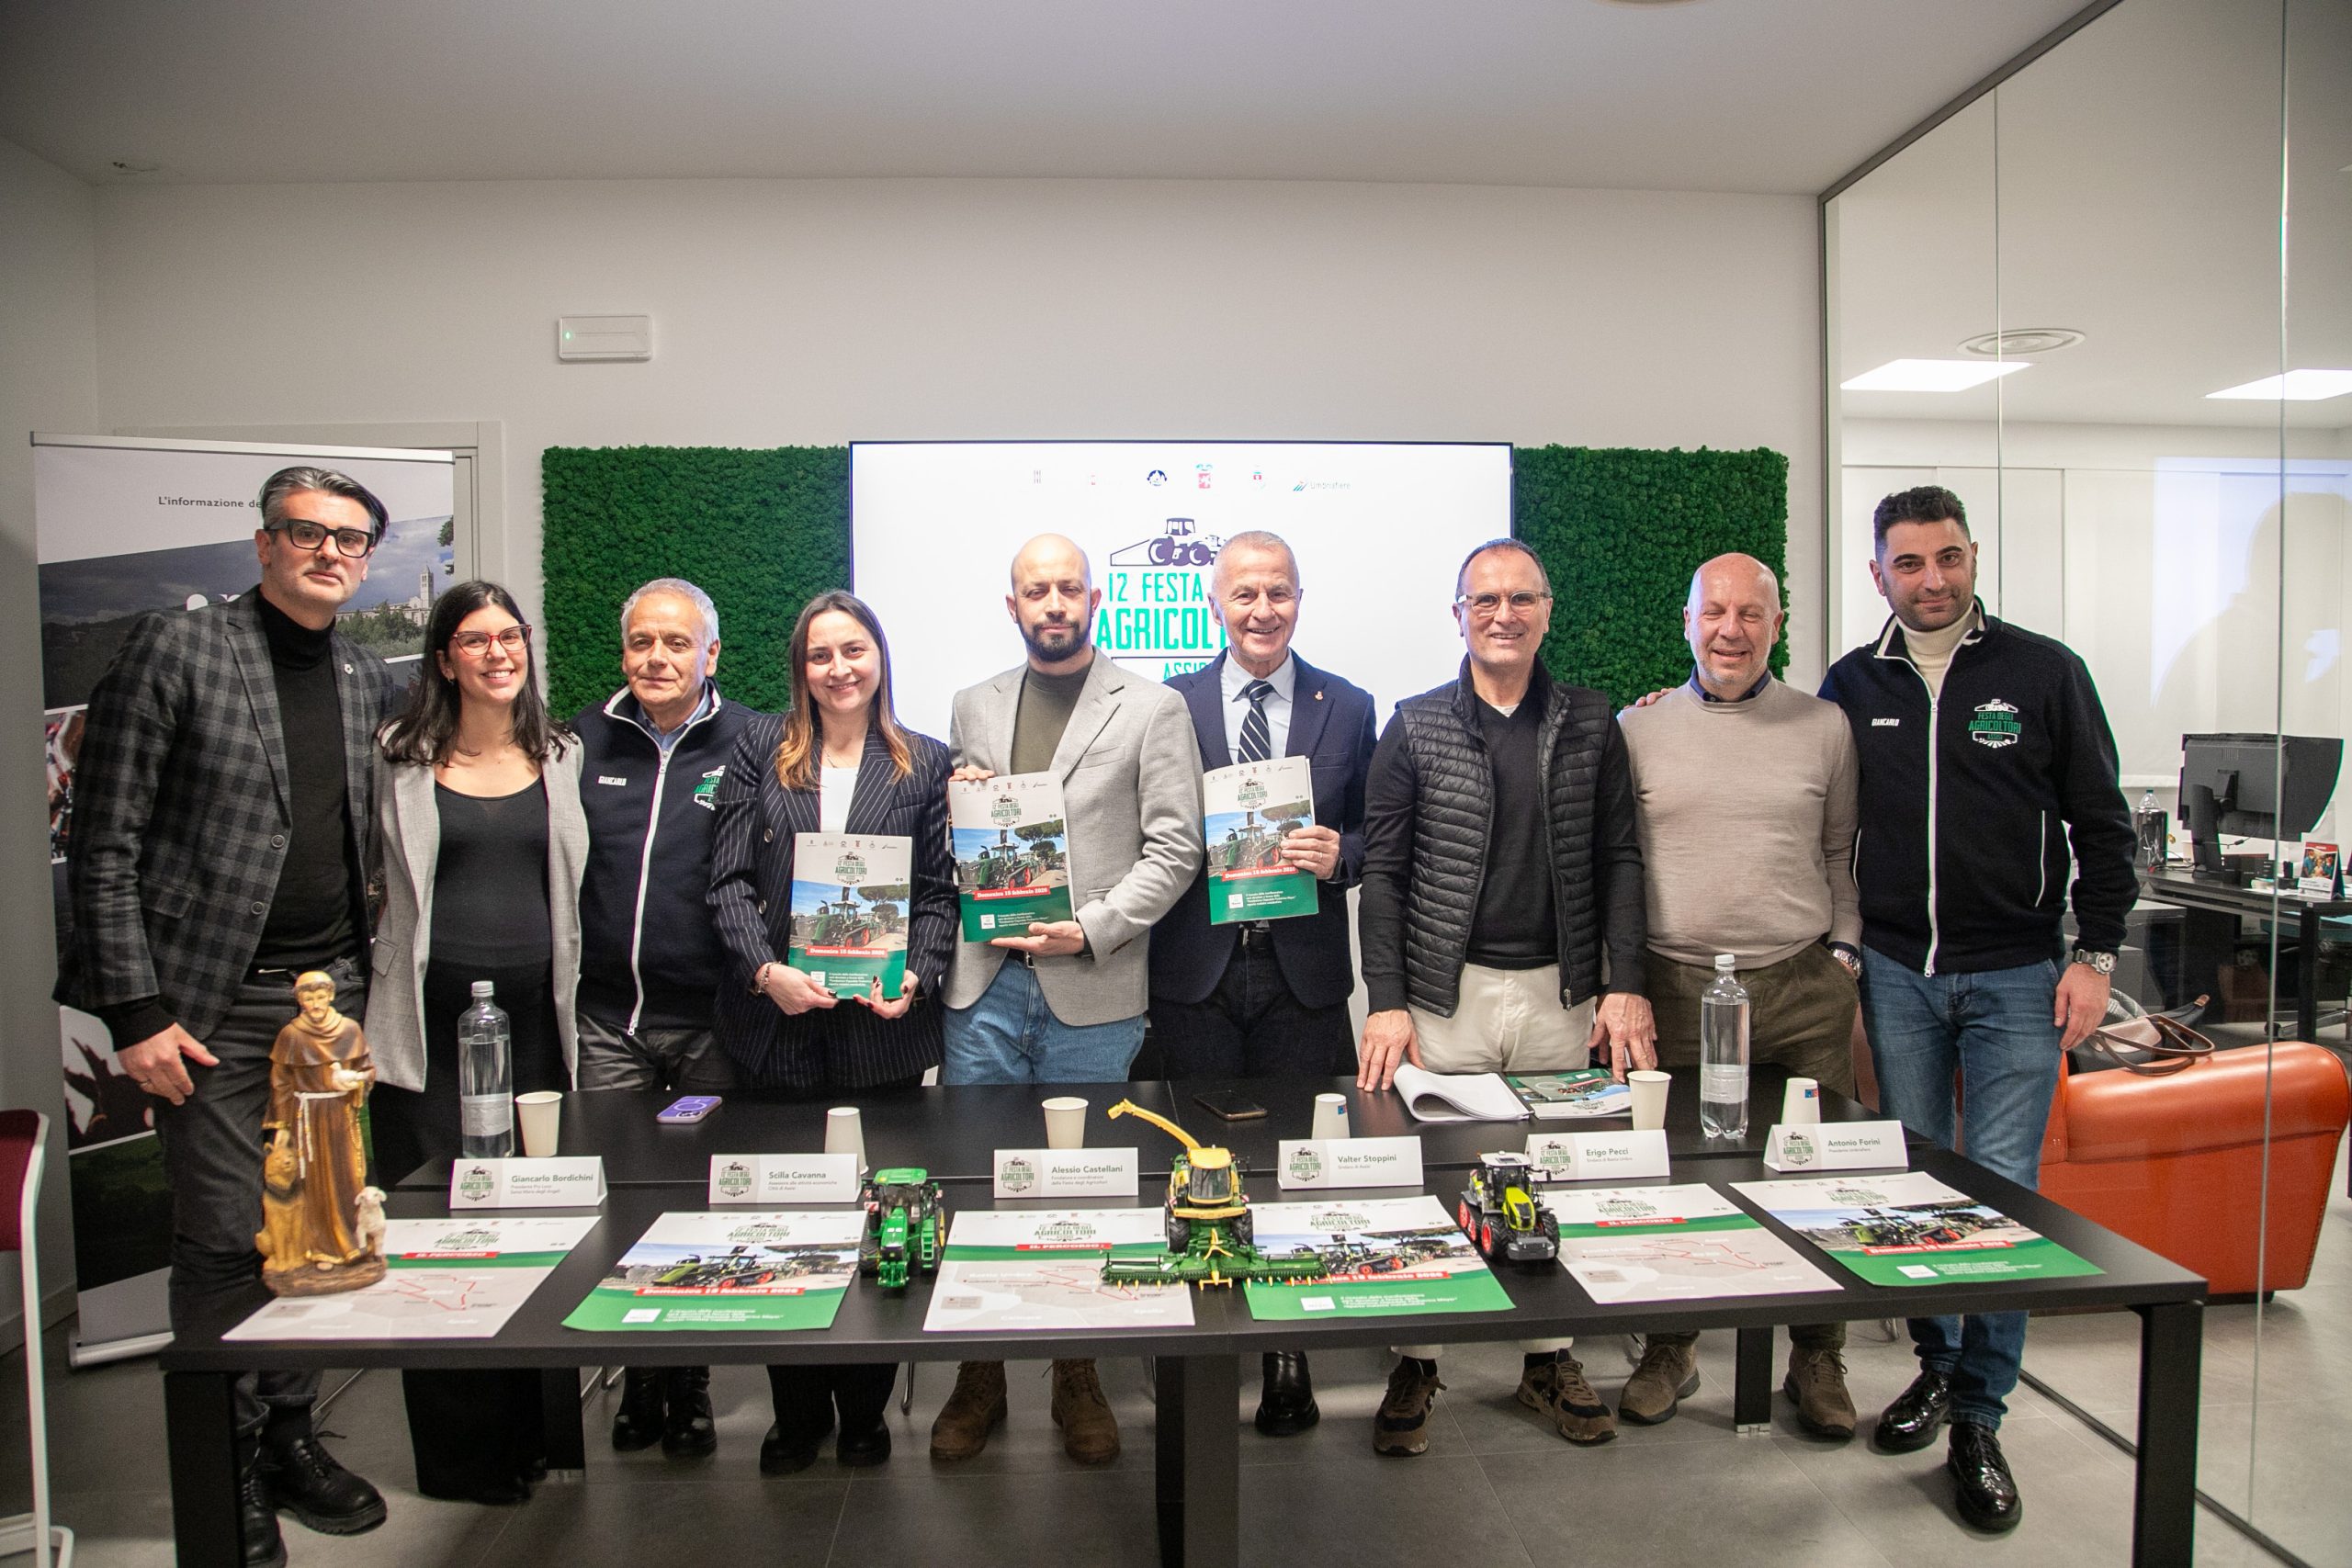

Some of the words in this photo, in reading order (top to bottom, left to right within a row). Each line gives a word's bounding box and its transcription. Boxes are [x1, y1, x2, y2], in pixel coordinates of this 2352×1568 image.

[158, 496, 244, 507] L'informazione
[1142, 573, 1204, 603] FESTA
[1095, 608, 1226, 649] AGRICOL
[1978, 712, 1996, 720] FESTA
[1968, 720, 2021, 734] AGRICOLTORI
[1586, 1149, 1606, 1157] Erigo
[1363, 1154, 1396, 1164] Stoppini
[1083, 1165, 1123, 1173] Castellani
[768, 1171, 789, 1179] Scilla
